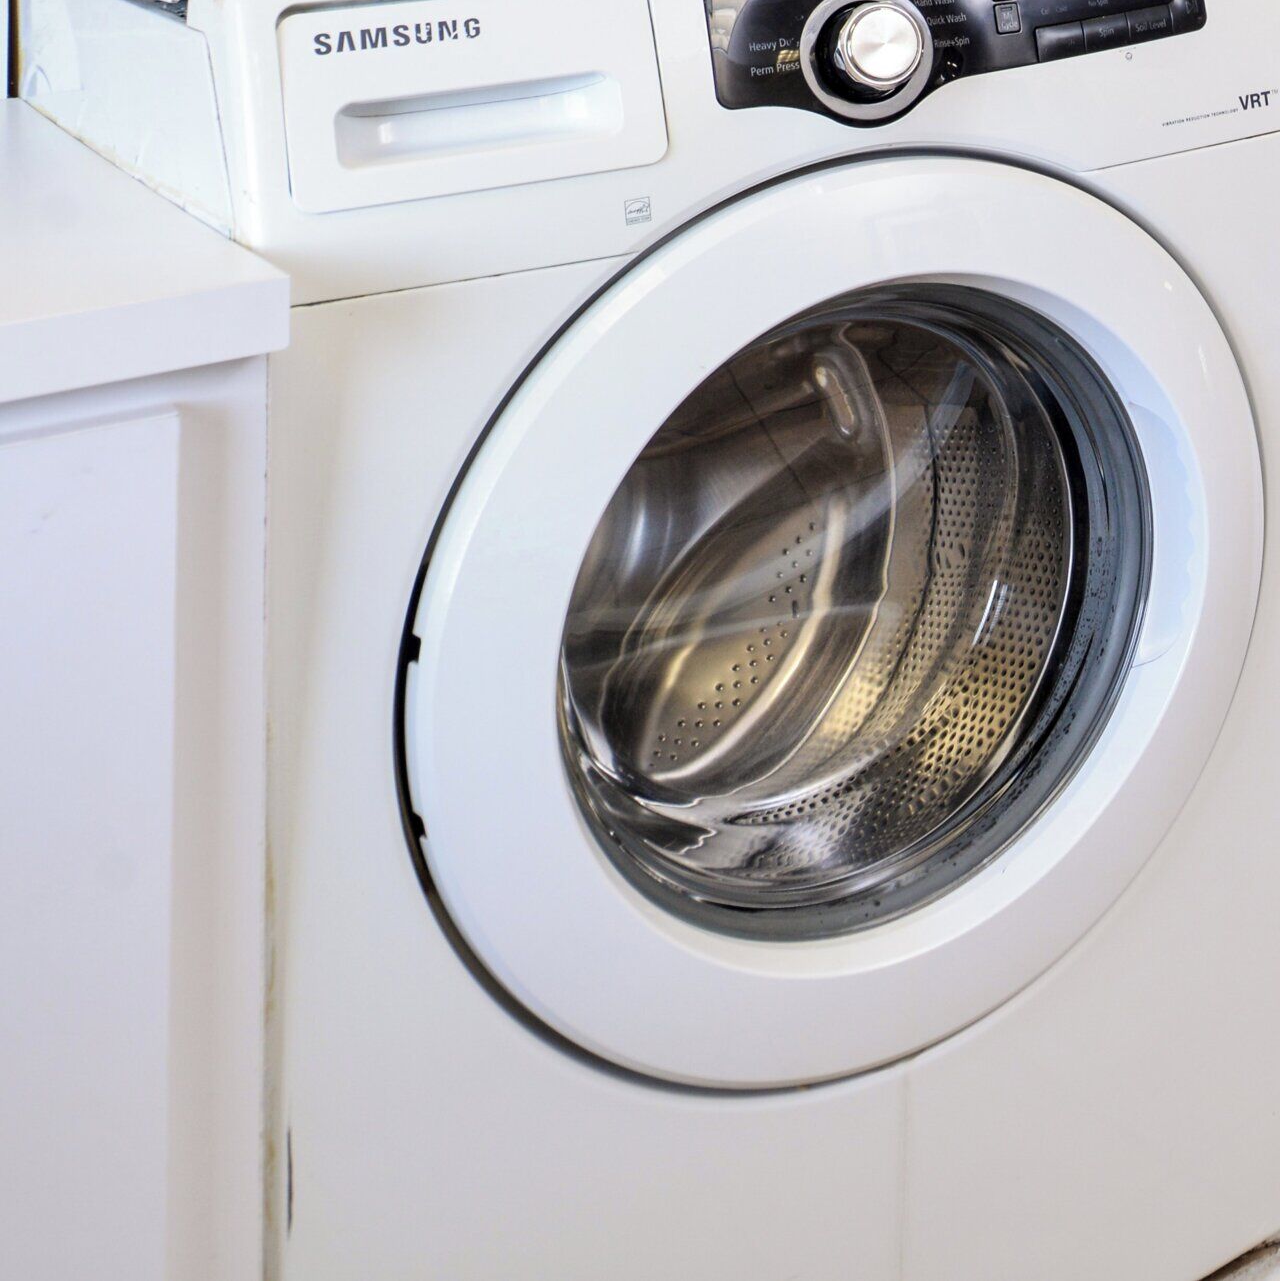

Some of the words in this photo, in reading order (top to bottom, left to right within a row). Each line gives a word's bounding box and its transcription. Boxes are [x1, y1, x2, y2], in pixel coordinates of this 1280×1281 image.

[945, 12, 967, 23] Wash
[314, 18, 481, 55] SAMSUNG
[749, 39, 776, 52] Heavy
[750, 64, 774, 77] Perm
[776, 61, 800, 73] Press
